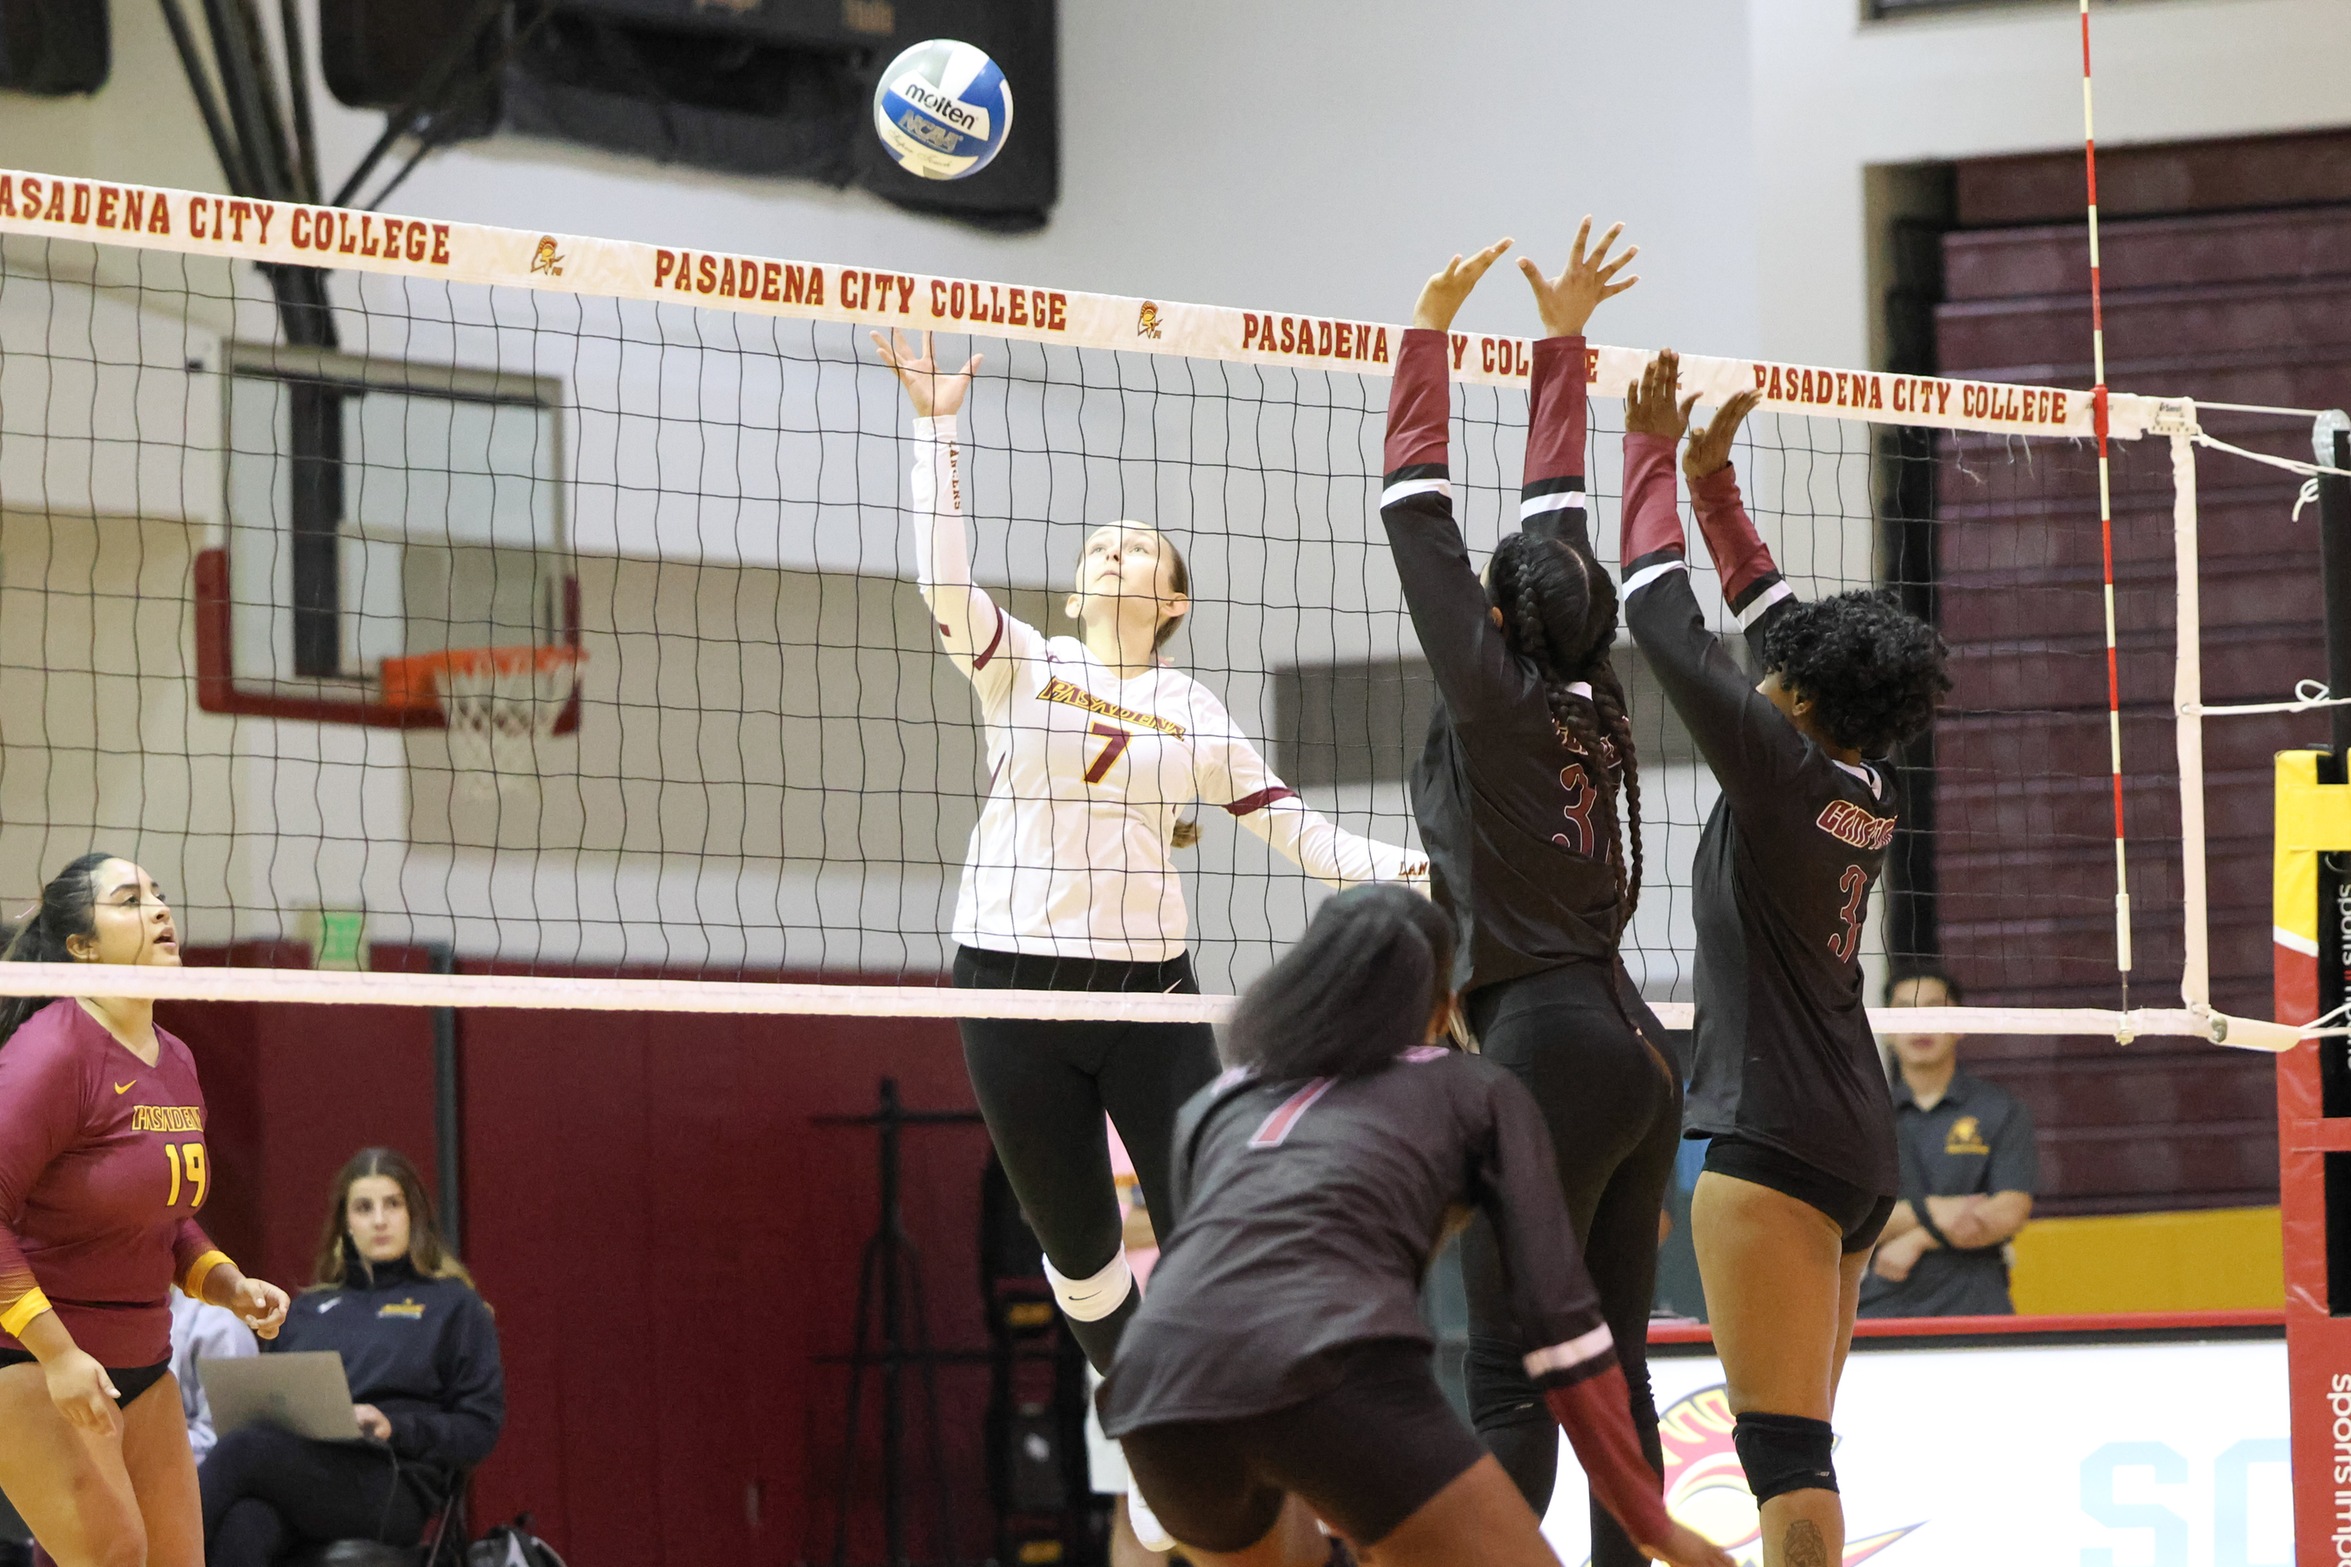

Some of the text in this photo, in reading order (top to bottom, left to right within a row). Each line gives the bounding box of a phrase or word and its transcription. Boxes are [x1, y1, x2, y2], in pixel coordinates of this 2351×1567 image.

[897, 109, 960, 154] NCAA
[903, 83, 977, 131] molten
[0, 174, 451, 266] ASADENA CITY COLLEGE
[653, 248, 1068, 331] PASADENA CITY COLLEGE
[1242, 312, 1389, 363] PASADENA
[1752, 363, 2068, 425] PASADENA CITY COLLEGE
[1036, 675, 1187, 742] PASADENA
[1082, 719, 1134, 788] 7
[164, 1143, 207, 1207] 19
